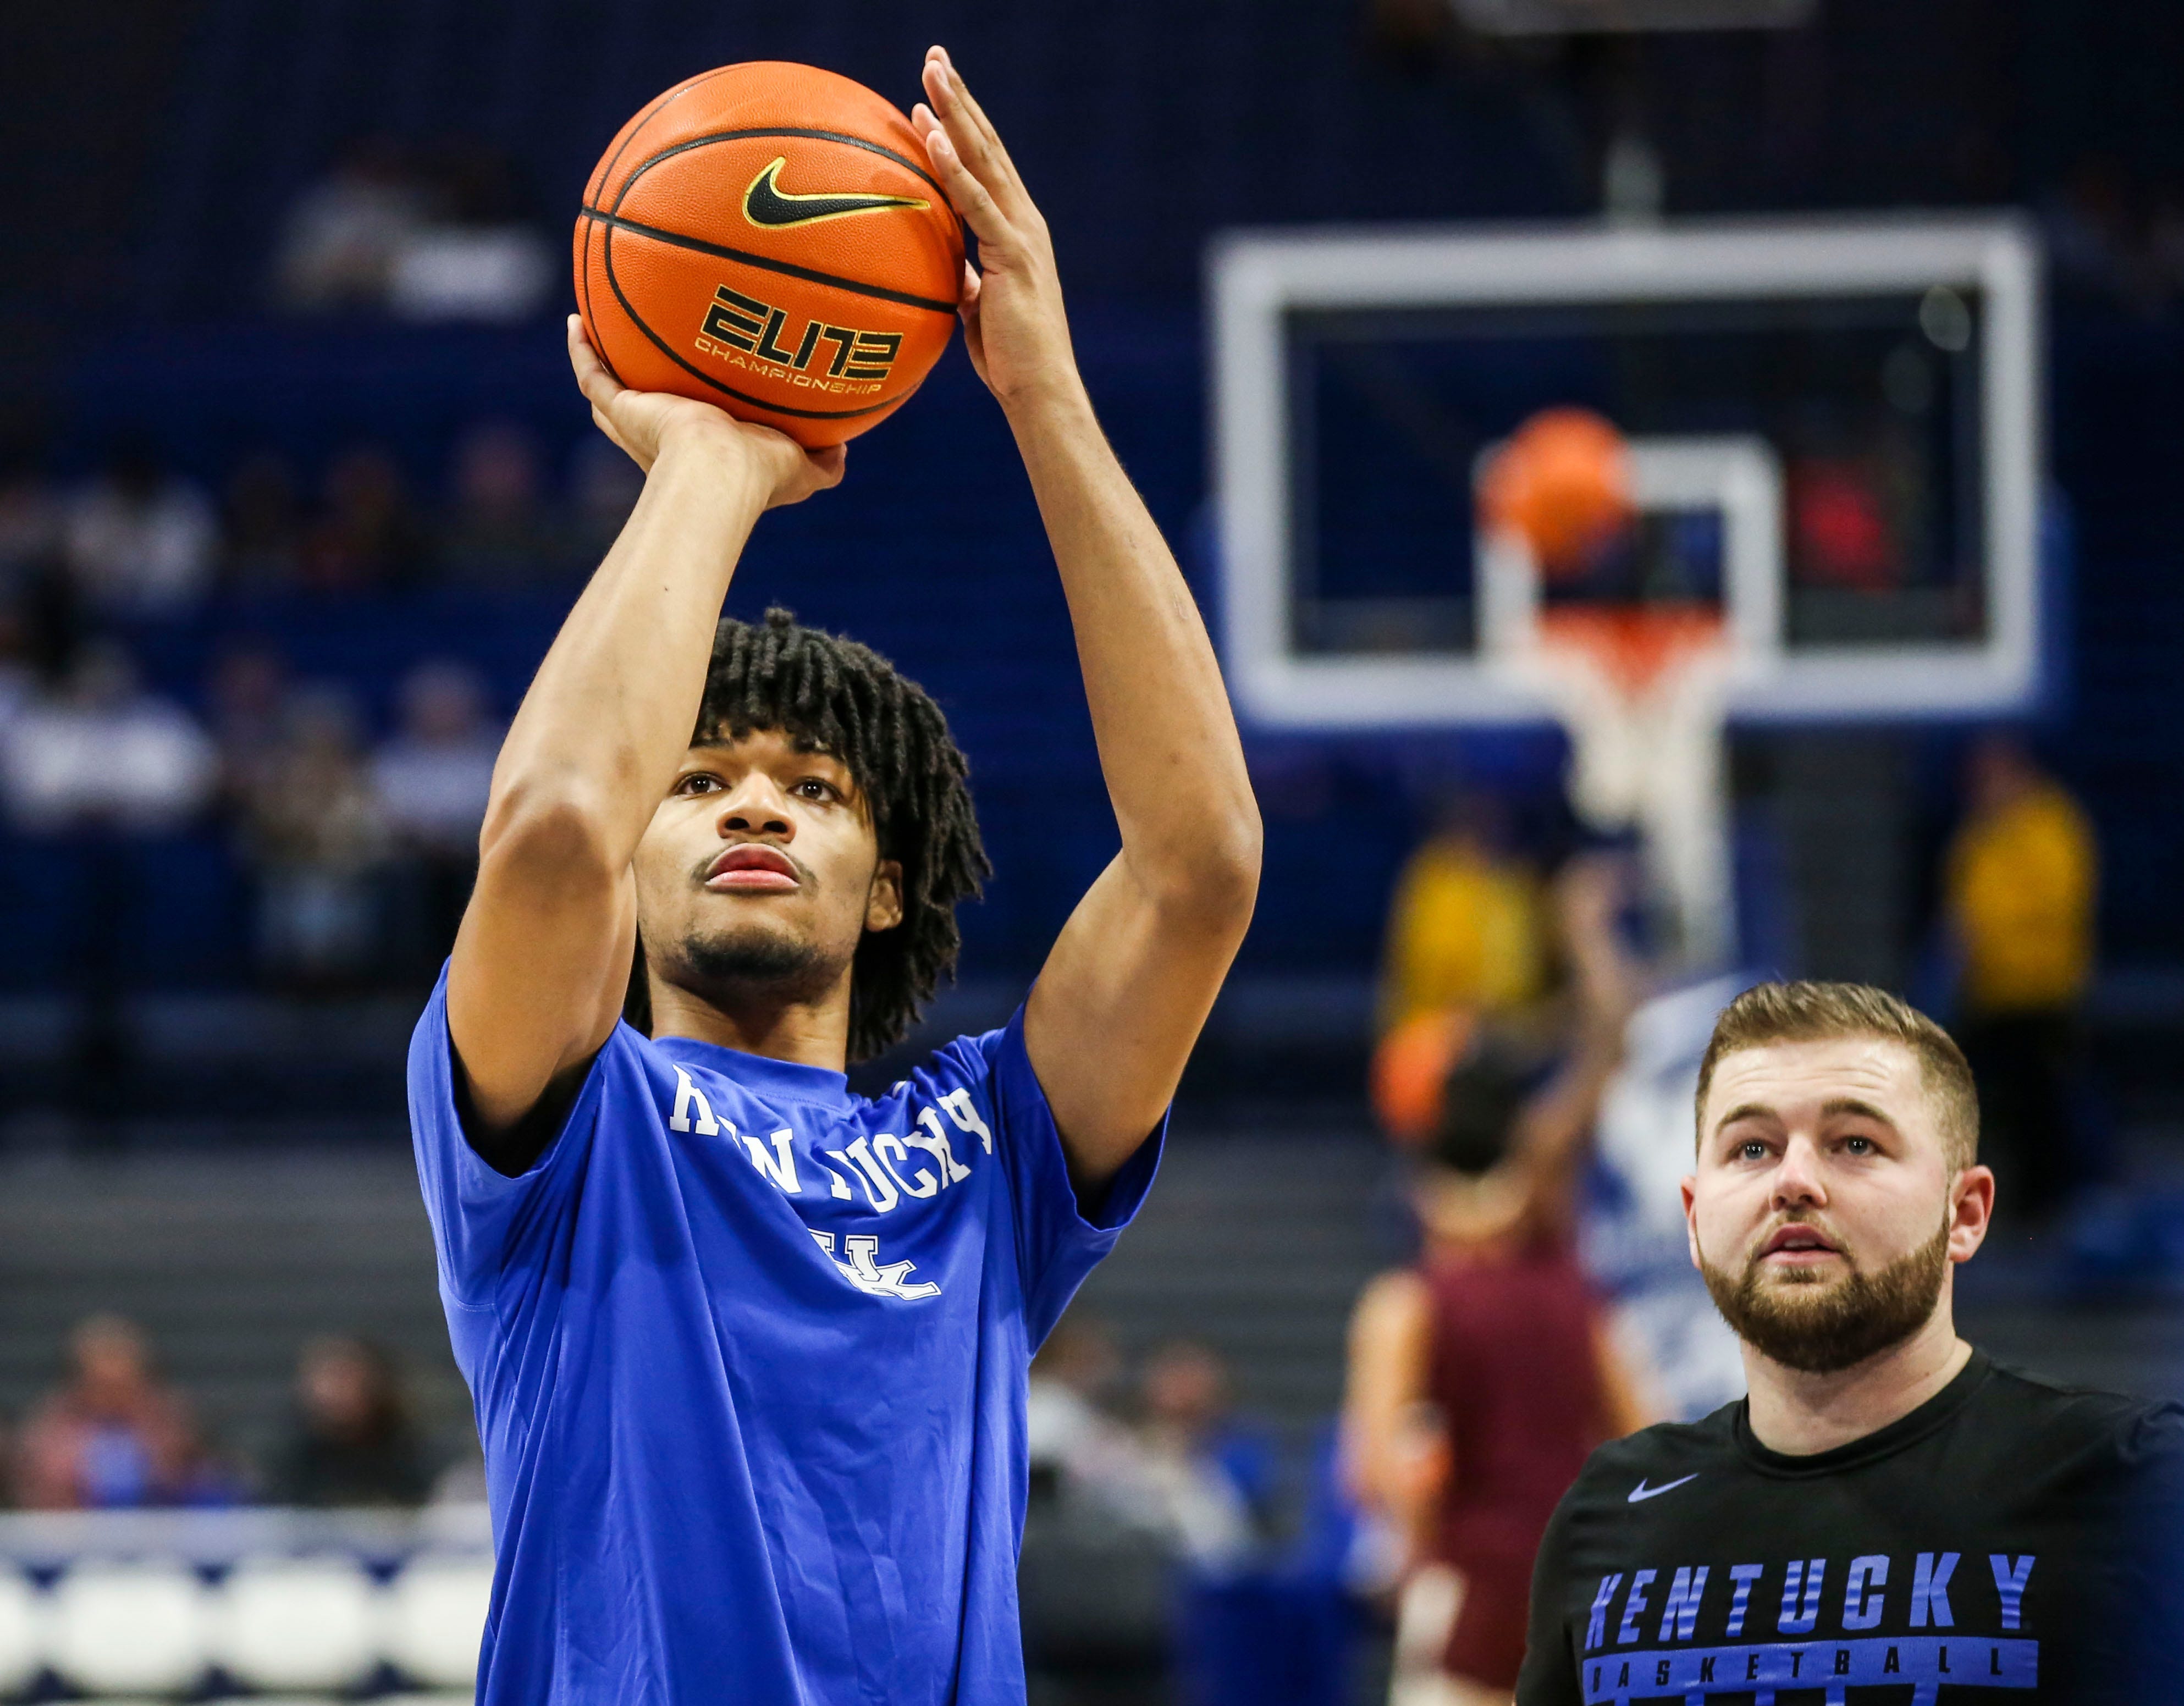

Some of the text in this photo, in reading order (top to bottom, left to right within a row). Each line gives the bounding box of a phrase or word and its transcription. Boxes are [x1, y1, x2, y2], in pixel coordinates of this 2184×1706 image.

[694, 337, 881, 395] CHAMPIONSHIP
[701, 284, 904, 380] ELITE
[1585, 1552, 2036, 1649] KENTUCKY
[1593, 1646, 2003, 1693] BASKETBALL
